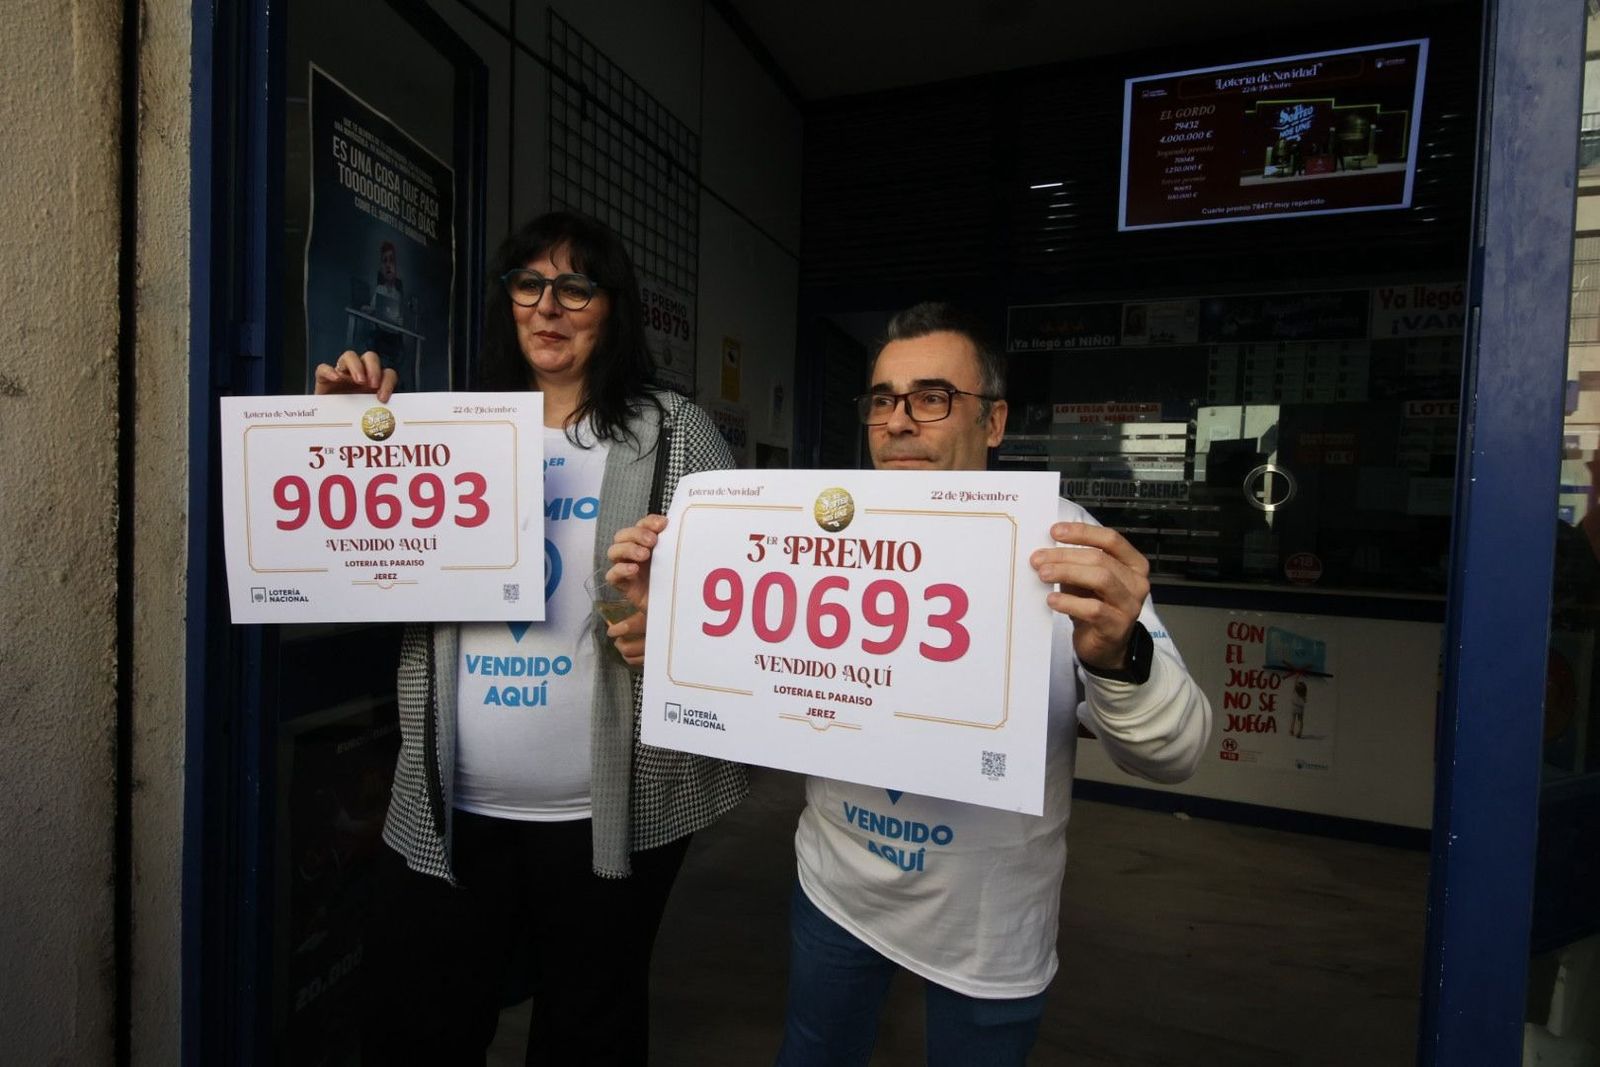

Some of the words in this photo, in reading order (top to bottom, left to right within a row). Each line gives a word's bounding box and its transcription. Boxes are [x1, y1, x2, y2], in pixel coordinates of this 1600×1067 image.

[1257, 73, 1271, 84] de
[1272, 64, 1319, 82] Navidad
[1160, 110, 1172, 120] EL
[1175, 104, 1216, 118] GORDO
[332, 135, 348, 162] ES
[350, 144, 372, 178] UNA
[375, 162, 401, 195] COSA
[402, 179, 420, 206] QUE
[420, 192, 440, 221] PASA
[401, 199, 417, 226] LOS
[652, 292, 687, 318] PREMIO
[1378, 288, 1407, 310] Ya
[1064, 336, 1076, 347] al
[1079, 334, 1116, 346] NIÑO!
[273, 410, 283, 418] de
[284, 409, 316, 418] Navidad
[453, 406, 463, 414] 22
[463, 406, 473, 414] de
[474, 406, 517, 415] Diciembre
[340, 443, 451, 469] PREMIO
[715, 488, 726, 496] de
[727, 487, 761, 497] Navidad
[931, 490, 943, 500] 22
[944, 491, 957, 501] de
[959, 492, 1019, 503] Diciembre
[1091, 481, 1138, 497] CIUDAD
[272, 472, 490, 531] 90693
[544, 497, 602, 521] MIO
[326, 539, 394, 553] VENDIDO
[398, 535, 437, 554] AQUÍ
[782, 535, 922, 573] PREMIO
[345, 560, 379, 568] LOTERIA
[390, 559, 425, 567] PARAISO
[269, 595, 310, 603] NACIONAL
[702, 567, 973, 663] 90693
[1227, 621, 1265, 644] CON
[1225, 643, 1245, 664] EL
[465, 654, 573, 678] VENDIDO
[754, 654, 836, 680] VENDIDO
[841, 664, 893, 689] AQUÍ
[1225, 668, 1282, 690] JUEGO
[483, 681, 549, 707] AQUÍ
[774, 684, 815, 699] LOTERIA
[815, 689, 827, 700] EL
[828, 691, 873, 707] PARAISO
[1223, 692, 1252, 710] NO
[1258, 692, 1278, 712] SE
[683, 708, 719, 722] LOTERÍA
[683, 717, 726, 732] NACIONAL
[806, 708, 836, 720] JEREZ
[1222, 713, 1277, 734] JUEGA
[843, 801, 954, 846] VENDIDO
